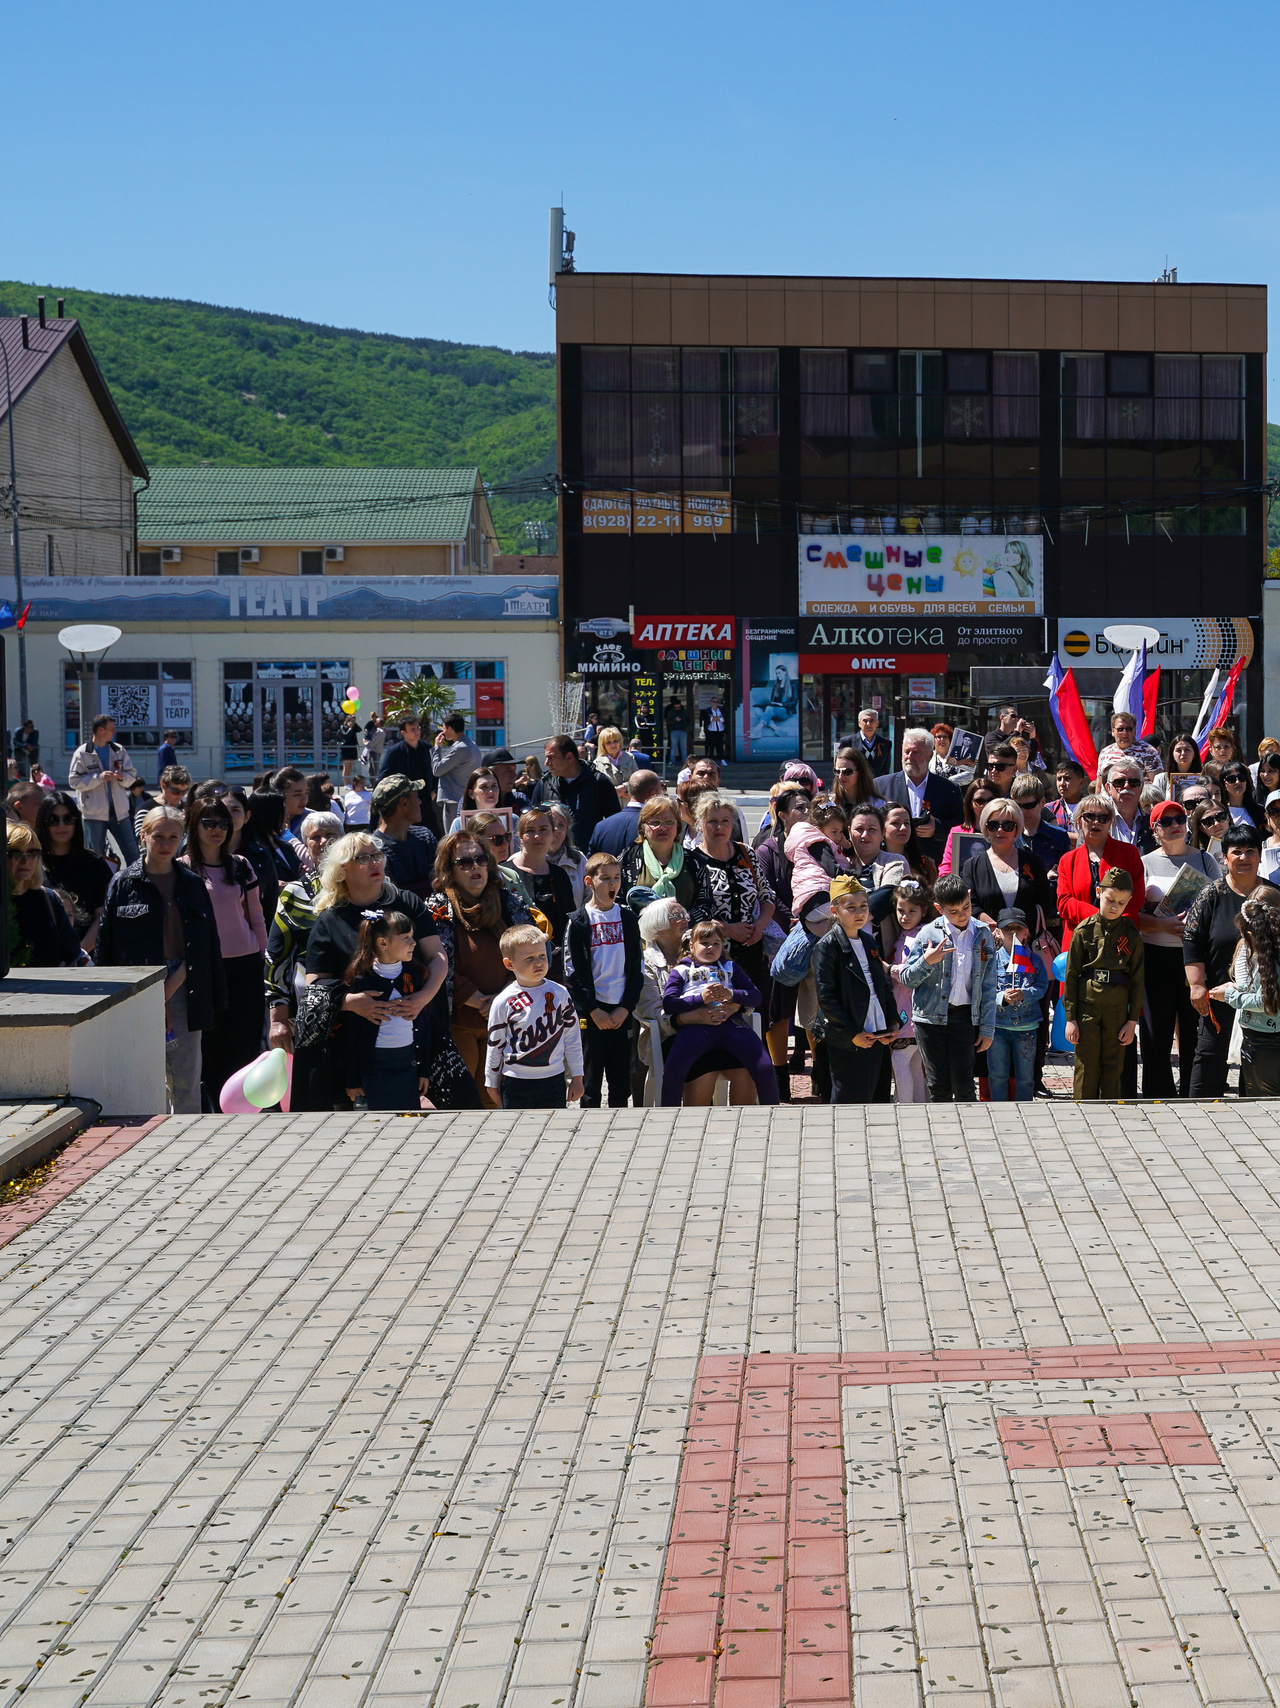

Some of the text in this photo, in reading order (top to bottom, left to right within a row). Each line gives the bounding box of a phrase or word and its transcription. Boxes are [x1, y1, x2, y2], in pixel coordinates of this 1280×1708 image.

[636, 498, 680, 511] УЮТНЫЕ
[688, 498, 728, 511] НОМЕРА
[583, 515, 724, 529] 8(928) 22-11 999
[224, 580, 328, 616] ТЕАТР
[812, 601, 1025, 614] ОДЕЖДА И ОБУВЬ ДЛЯ ВСЕЙ СЕМЬИ
[638, 623, 732, 641] АПТЕКА
[957, 627, 1023, 636] От элитного
[957, 636, 1017, 646] до простого
[595, 644, 622, 652] КАФЕ
[577, 662, 641, 673] МИМИНО
[673, 660, 717, 671] ЦЕНЫ
[861, 658, 896, 670] МТС
[634, 678, 655, 686] ТЕЛ.
[170, 698, 184, 706] ЕСТЬ
[164, 707, 190, 719] ТЕАТР
[508, 991, 533, 1011] GO
